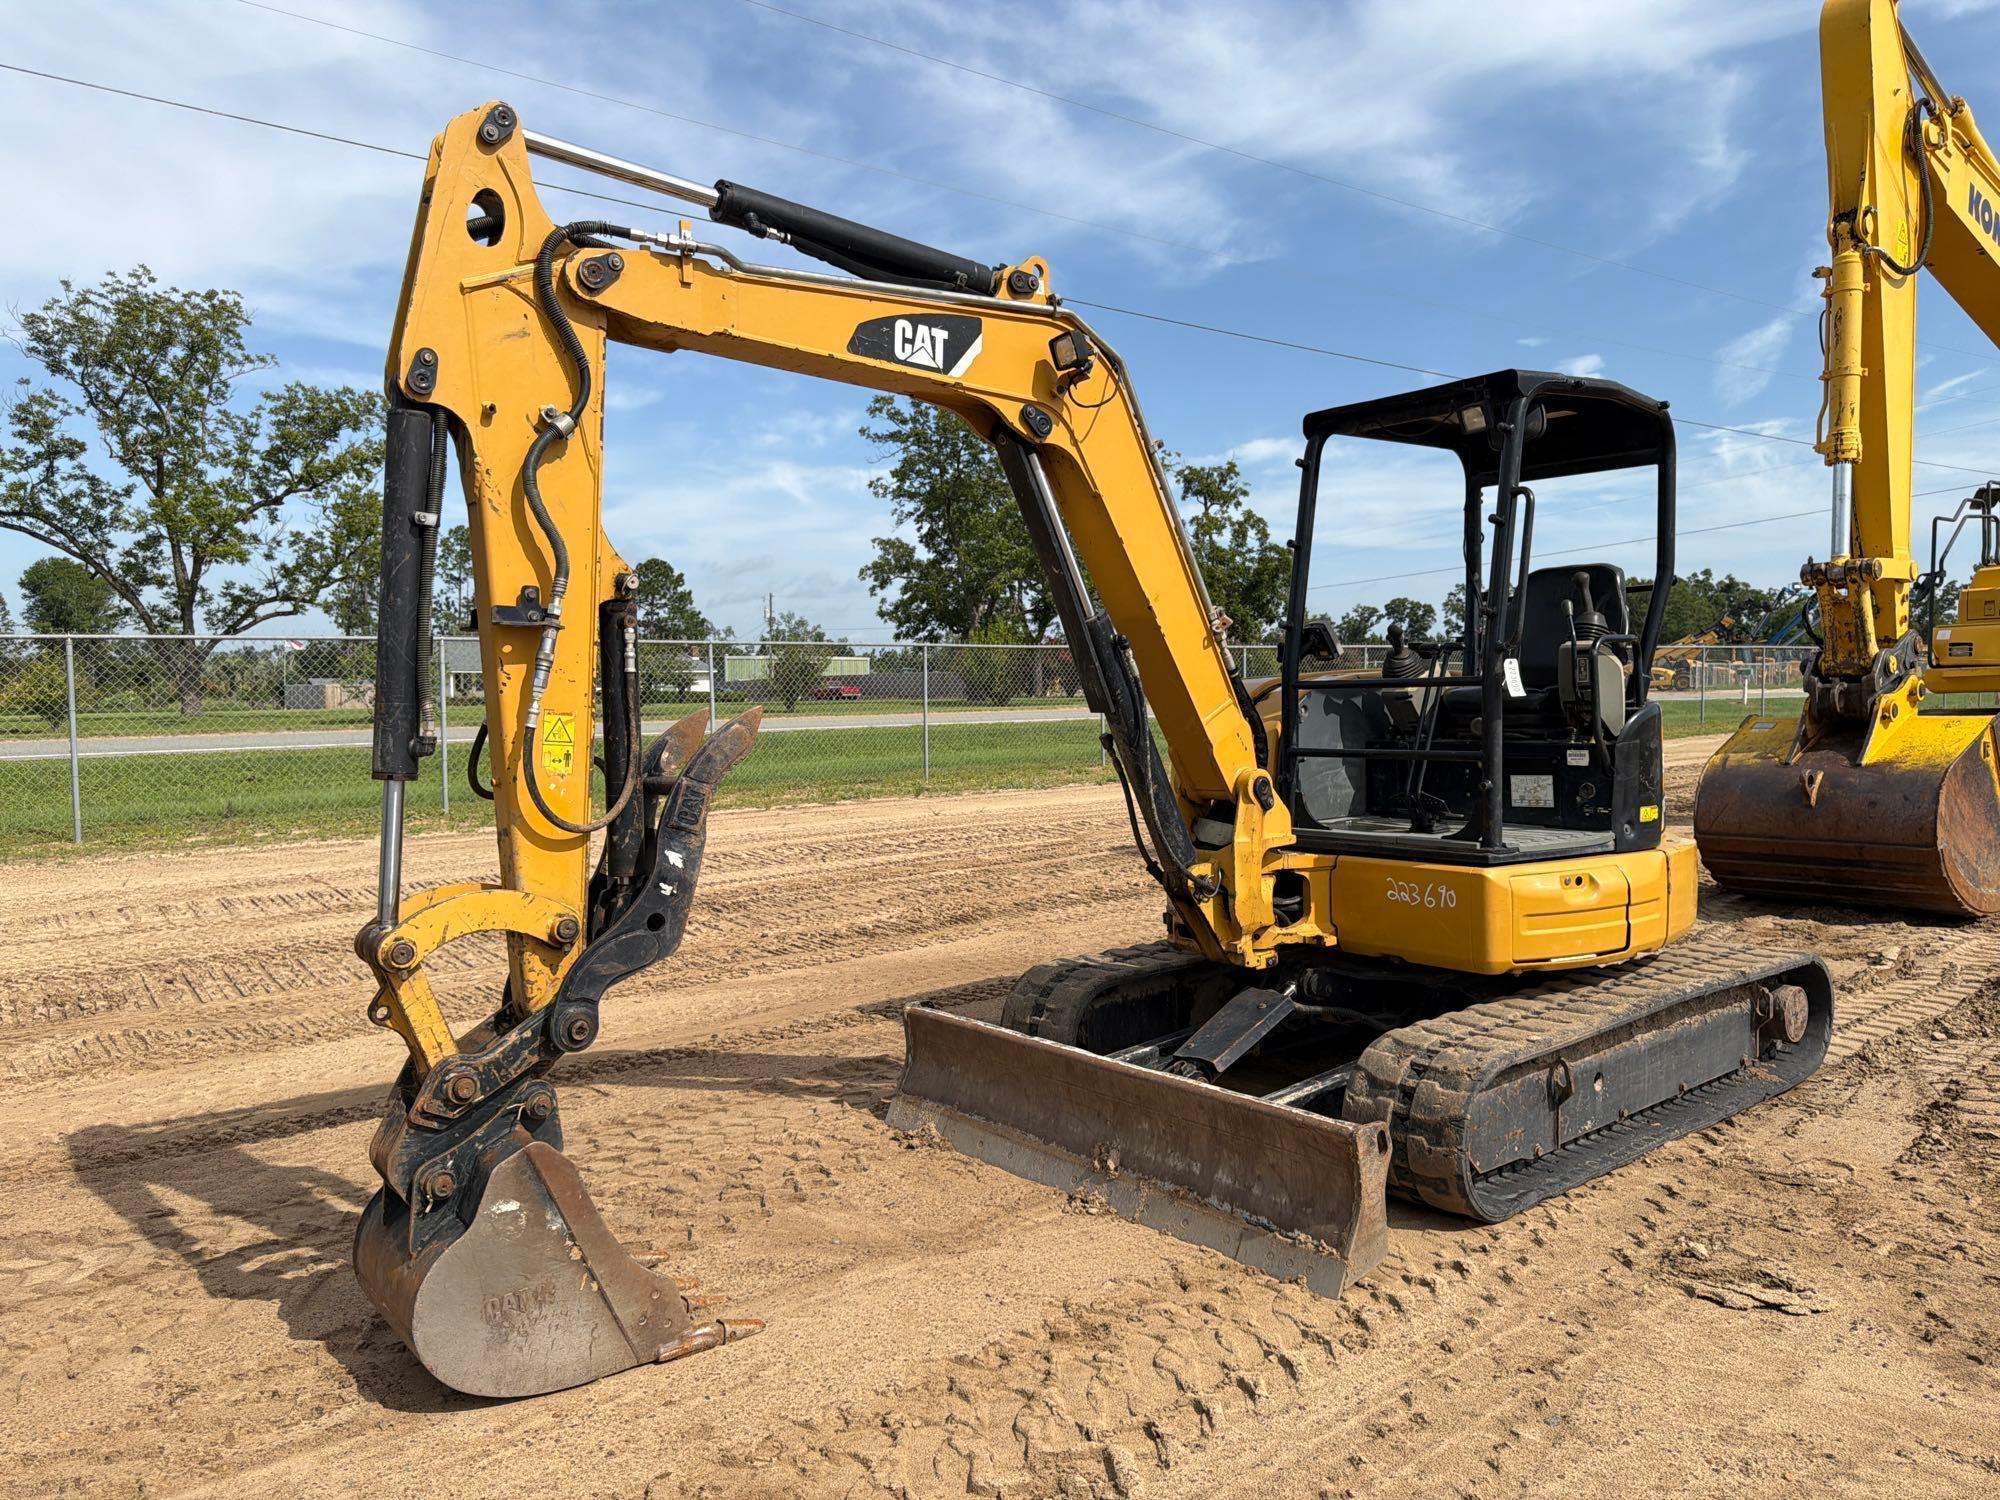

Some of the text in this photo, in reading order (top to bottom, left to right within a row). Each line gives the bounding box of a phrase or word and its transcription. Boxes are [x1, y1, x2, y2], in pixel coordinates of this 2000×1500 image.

[894, 318, 949, 371] CAT
[676, 785, 706, 827] CAT
[1386, 877, 1457, 908] 223690
